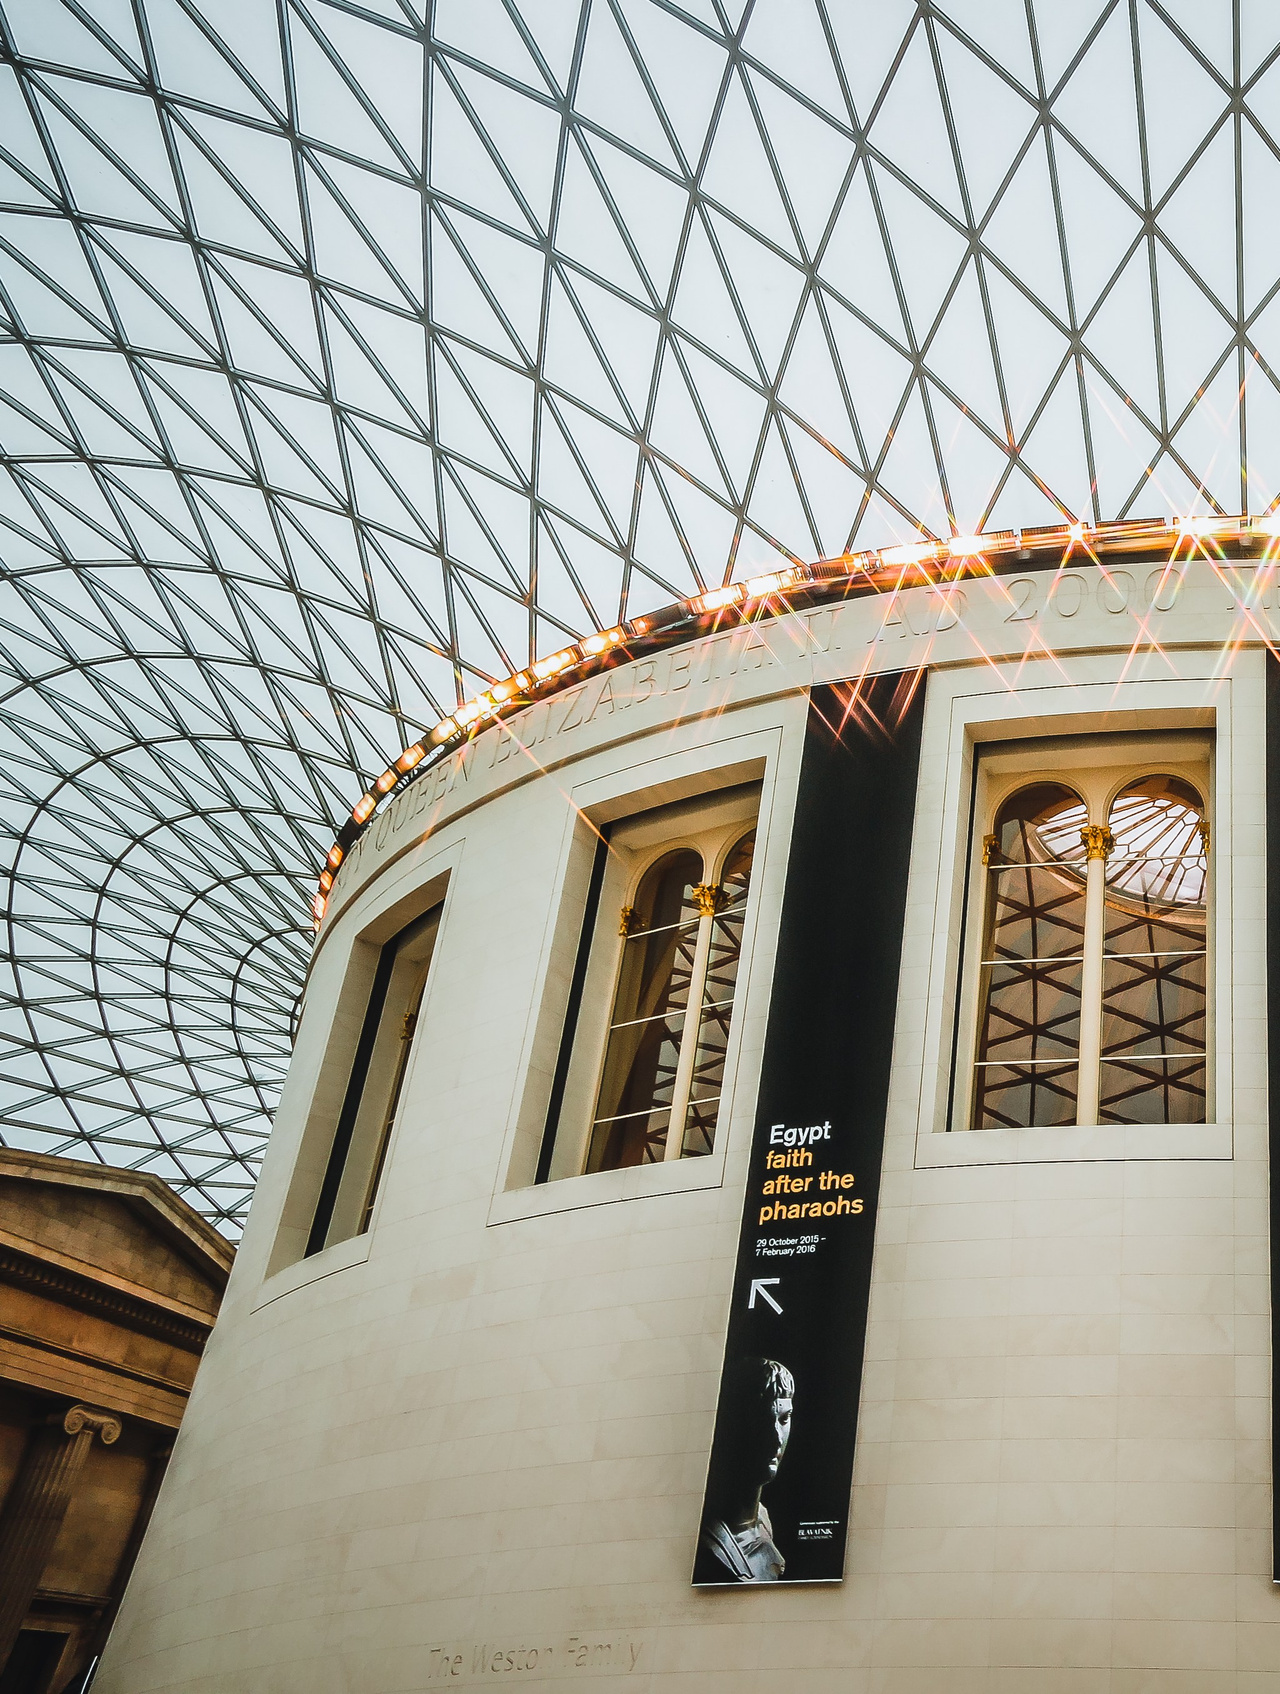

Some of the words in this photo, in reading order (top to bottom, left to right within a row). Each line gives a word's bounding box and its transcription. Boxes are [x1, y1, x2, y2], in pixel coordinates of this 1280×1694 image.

[1002, 566, 1186, 625] 2000
[769, 1121, 832, 1147] Egypt
[766, 1147, 813, 1170] faith
[762, 1175, 813, 1195] after
[819, 1170, 855, 1191] the
[759, 1195, 864, 1225] pharaohs
[755, 1248, 761, 1256] 7
[762, 1247, 794, 1256] February
[796, 1244, 816, 1253] 2016
[756, 1238, 767, 1247] 29
[769, 1237, 799, 1247] October
[799, 1234, 819, 1244] 2015
[427, 1647, 464, 1679] The
[471, 1642, 553, 1674] Weston
